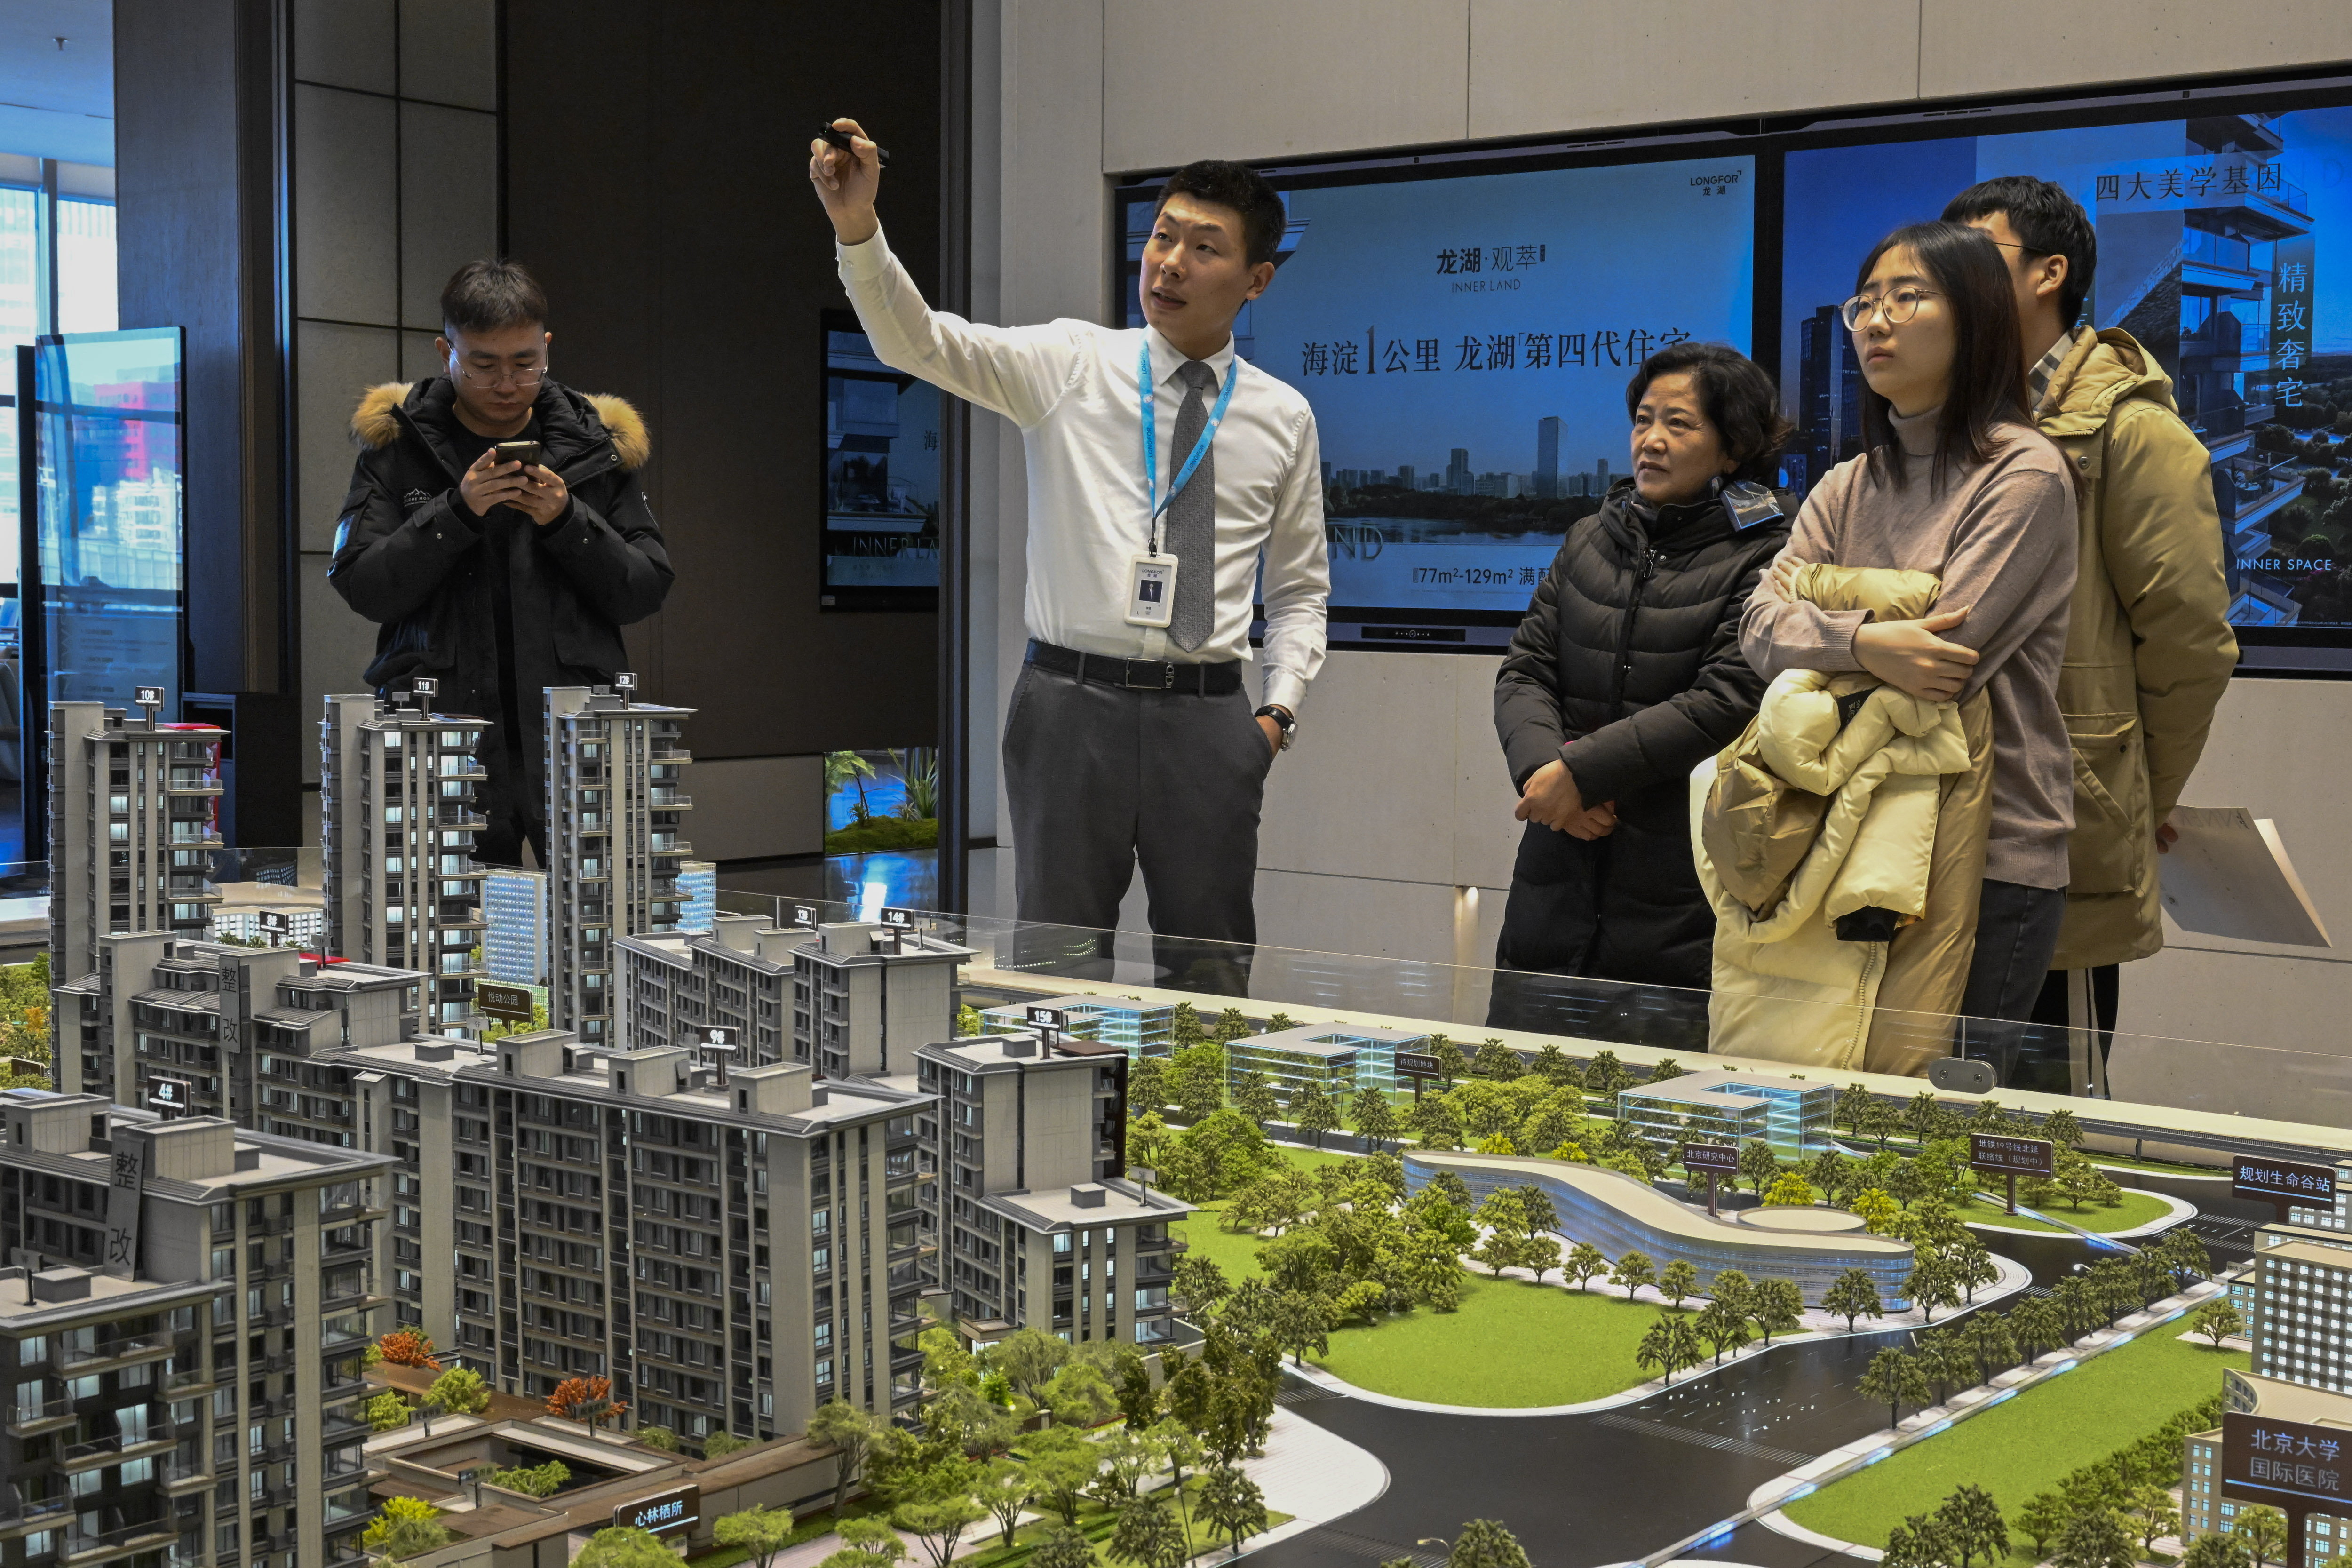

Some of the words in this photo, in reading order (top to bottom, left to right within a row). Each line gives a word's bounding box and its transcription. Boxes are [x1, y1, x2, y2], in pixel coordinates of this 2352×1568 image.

[1690, 175, 1738, 186] LONGFOR
[2097, 163, 2280, 201] 四大美学基因
[1703, 185, 1725, 196] 龙湖
[1452, 281, 1485, 293] INNER
[1490, 279, 1521, 291] LAND
[2275, 262, 2307, 407] 精致奢宅
[1301, 324, 1441, 376] 海淀1公里
[1224, 377, 1234, 401] LONGFOR
[1187, 444, 1205, 471] LONGFOR
[853, 536, 909, 559] INNER
[2237, 559, 2280, 570] INNER
[2288, 559, 2332, 570] SPACE
[418, 681, 429, 690] 11#
[619, 675, 629, 684] 12#
[141, 690, 154, 700] 10#
[267, 915, 277, 927] 8#
[798, 909, 808, 920] 13#
[888, 911, 905, 923] 14#
[222, 967, 237, 1043] 整改
[488, 991, 518, 1006] 悦动公园
[1034, 1010, 1052, 1023] 15#
[710, 1029, 724, 1044] 9#
[1400, 1058, 1433, 1069] 待规划地块
[159, 1083, 173, 1100] 4#
[1979, 1139, 2039, 1154] 地铁19号线北延
[1687, 1149, 1734, 1162] 北京研究中心
[1978, 1151, 2043, 1166] 联络线（规划中）
[2240, 1166, 2330, 1193] 规划生命谷站
[109, 1151, 138, 1266] 整改
[2251, 1429, 2340, 1461] 北京大学
[2250, 1457, 2340, 1491] 国际医院
[635, 1500, 682, 1527] 心林栖所
